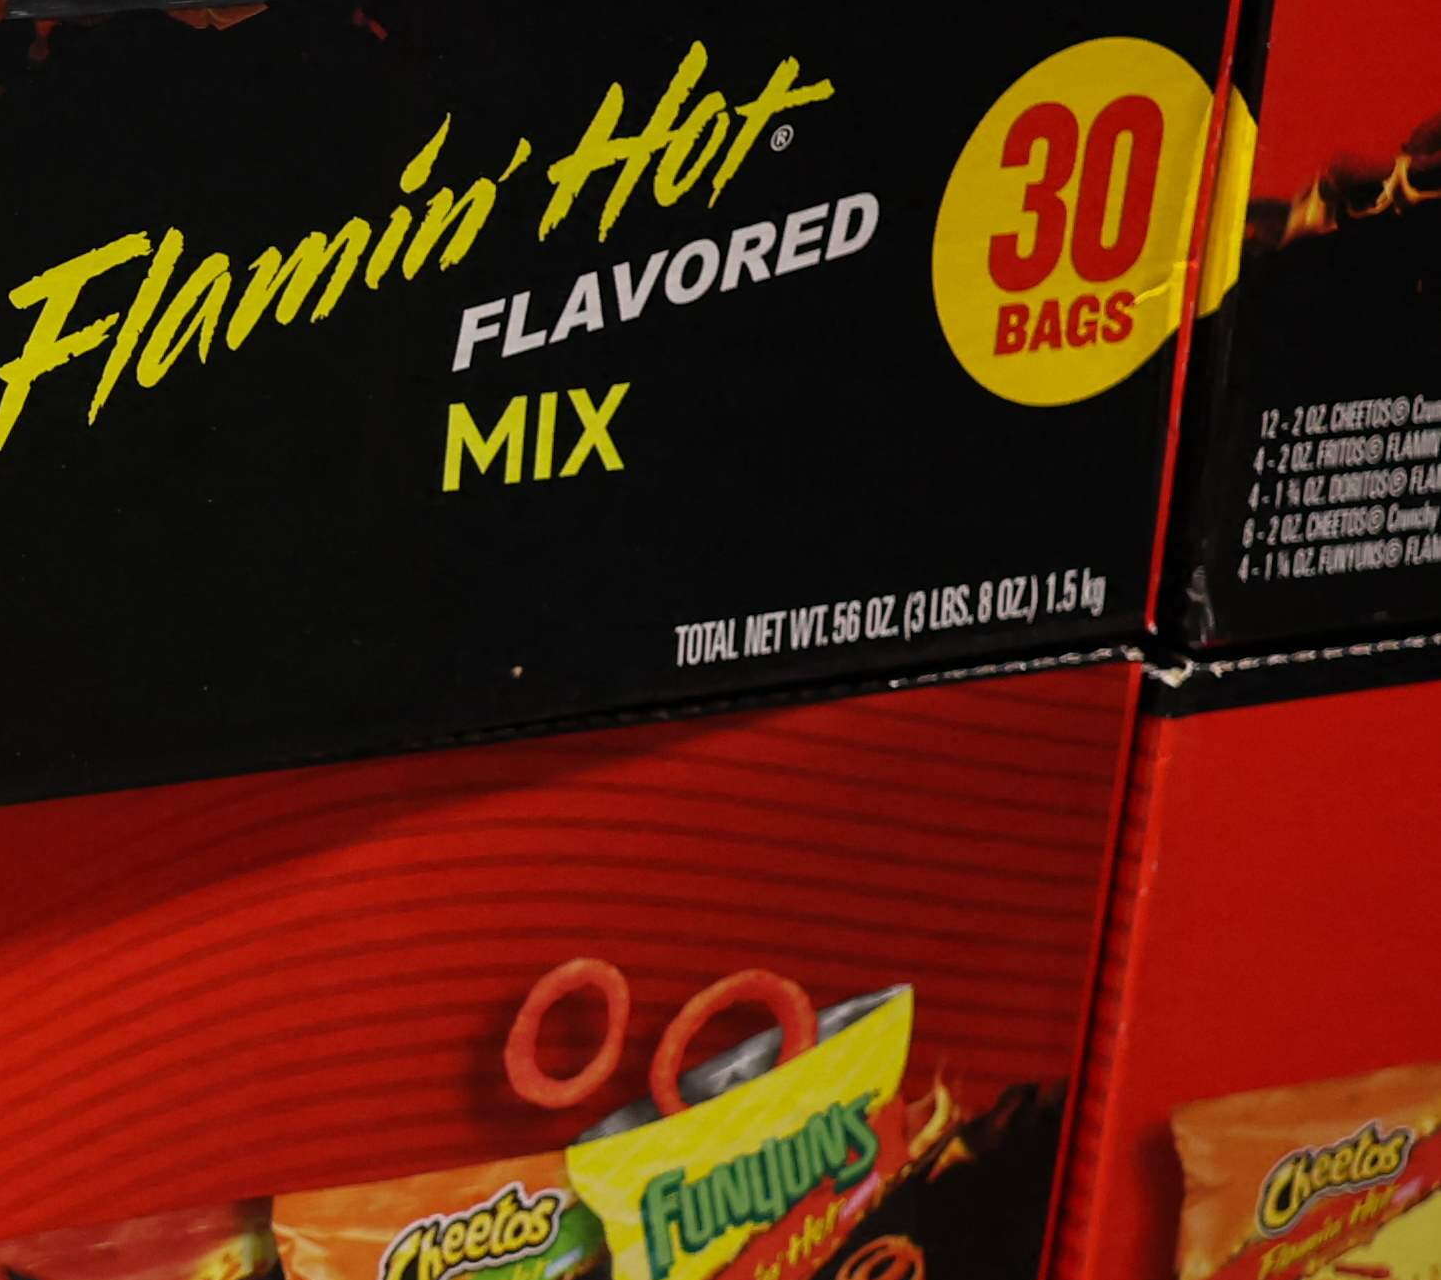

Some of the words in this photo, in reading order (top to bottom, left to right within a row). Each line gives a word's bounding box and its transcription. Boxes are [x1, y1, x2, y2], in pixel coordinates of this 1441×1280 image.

[987, 93, 1166, 294] 30
[451, 191, 880, 373] FLAVORED
[992, 290, 1140, 358] BAGS
[441, 382, 633, 493] MIX
[675, 621, 739, 668] TOTAL
[744, 611, 788, 657] NET
[790, 605, 828, 651] WT.
[833, 599, 861, 643] 56
[865, 594, 899, 639] OZ.
[904, 590, 926, 641] (3
[930, 583, 974, 630] LBS.
[977, 580, 993, 622] 8
[997, 574, 1038, 624] OZ.)
[1045, 569, 1077, 614] 1.5
[1080, 566, 1106, 617] kg
[1255, 1120, 1416, 1237] Cheetos
